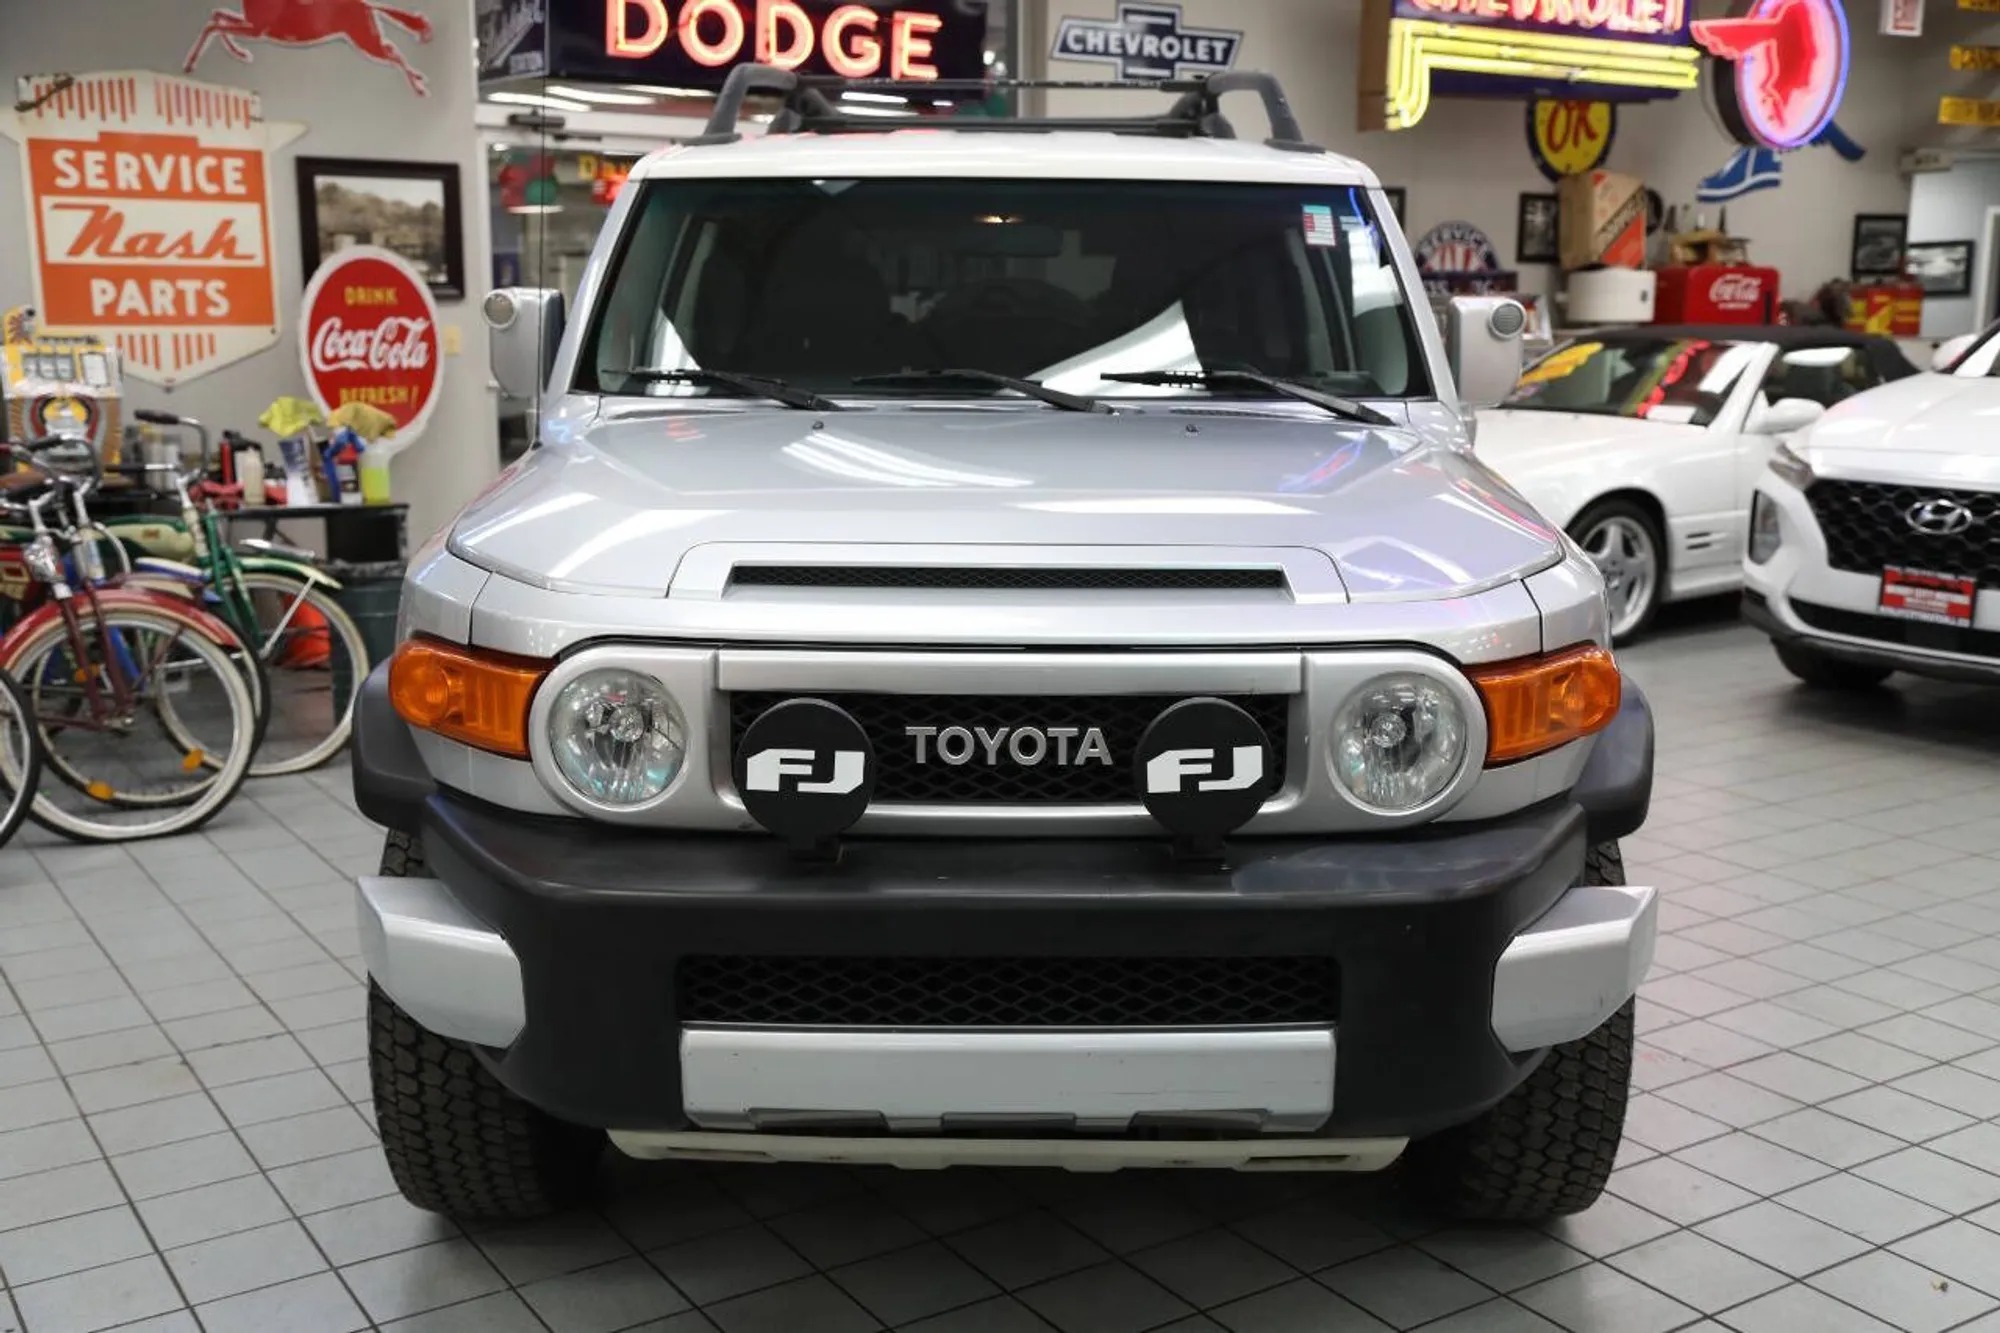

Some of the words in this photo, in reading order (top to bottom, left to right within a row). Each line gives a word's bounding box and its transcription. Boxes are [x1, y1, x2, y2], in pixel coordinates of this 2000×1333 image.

[606, 0, 942, 80] DODGE
[1066, 26, 1228, 62] CHEVROLET
[1546, 99, 1599, 153] OK
[52, 148, 248, 195] SERVICE
[51, 202, 256, 261] Nash
[90, 278, 230, 317] PARTS
[344, 285, 398, 306] DRINK
[312, 316, 430, 371] Coca-Cola
[905, 726, 1114, 766] TOYOTA
[1146, 745, 1263, 793] FJ
[747, 748, 866, 793] FJ
